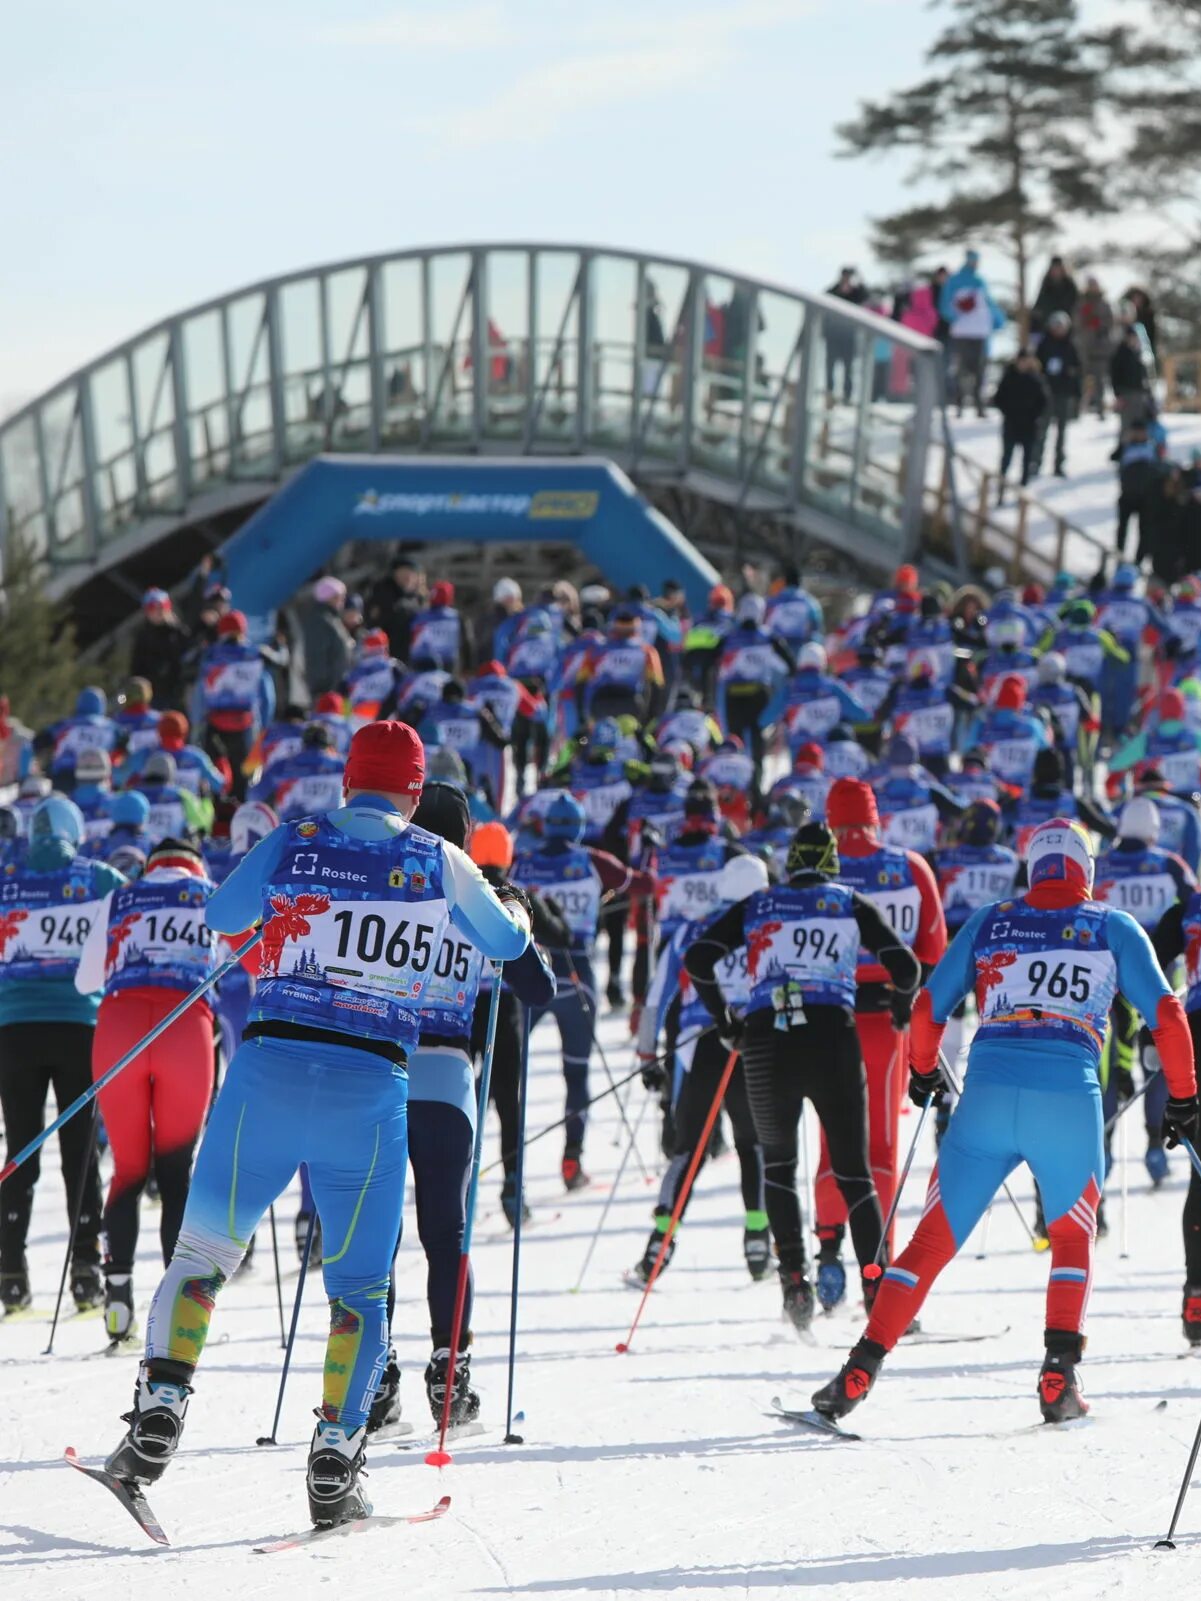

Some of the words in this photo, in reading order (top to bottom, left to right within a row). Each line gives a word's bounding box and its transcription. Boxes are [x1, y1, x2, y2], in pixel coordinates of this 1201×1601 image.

[321, 867, 368, 883] Rostec
[40, 916, 91, 946] 948
[145, 914, 212, 949] 1640
[334, 910, 435, 972] 1065
[793, 928, 840, 963] 994
[1010, 928, 1047, 939] Rostec
[282, 989, 321, 1003] RYBINSK
[1028, 960, 1092, 1004] 965
[360, 1320, 389, 1412] SPINE
